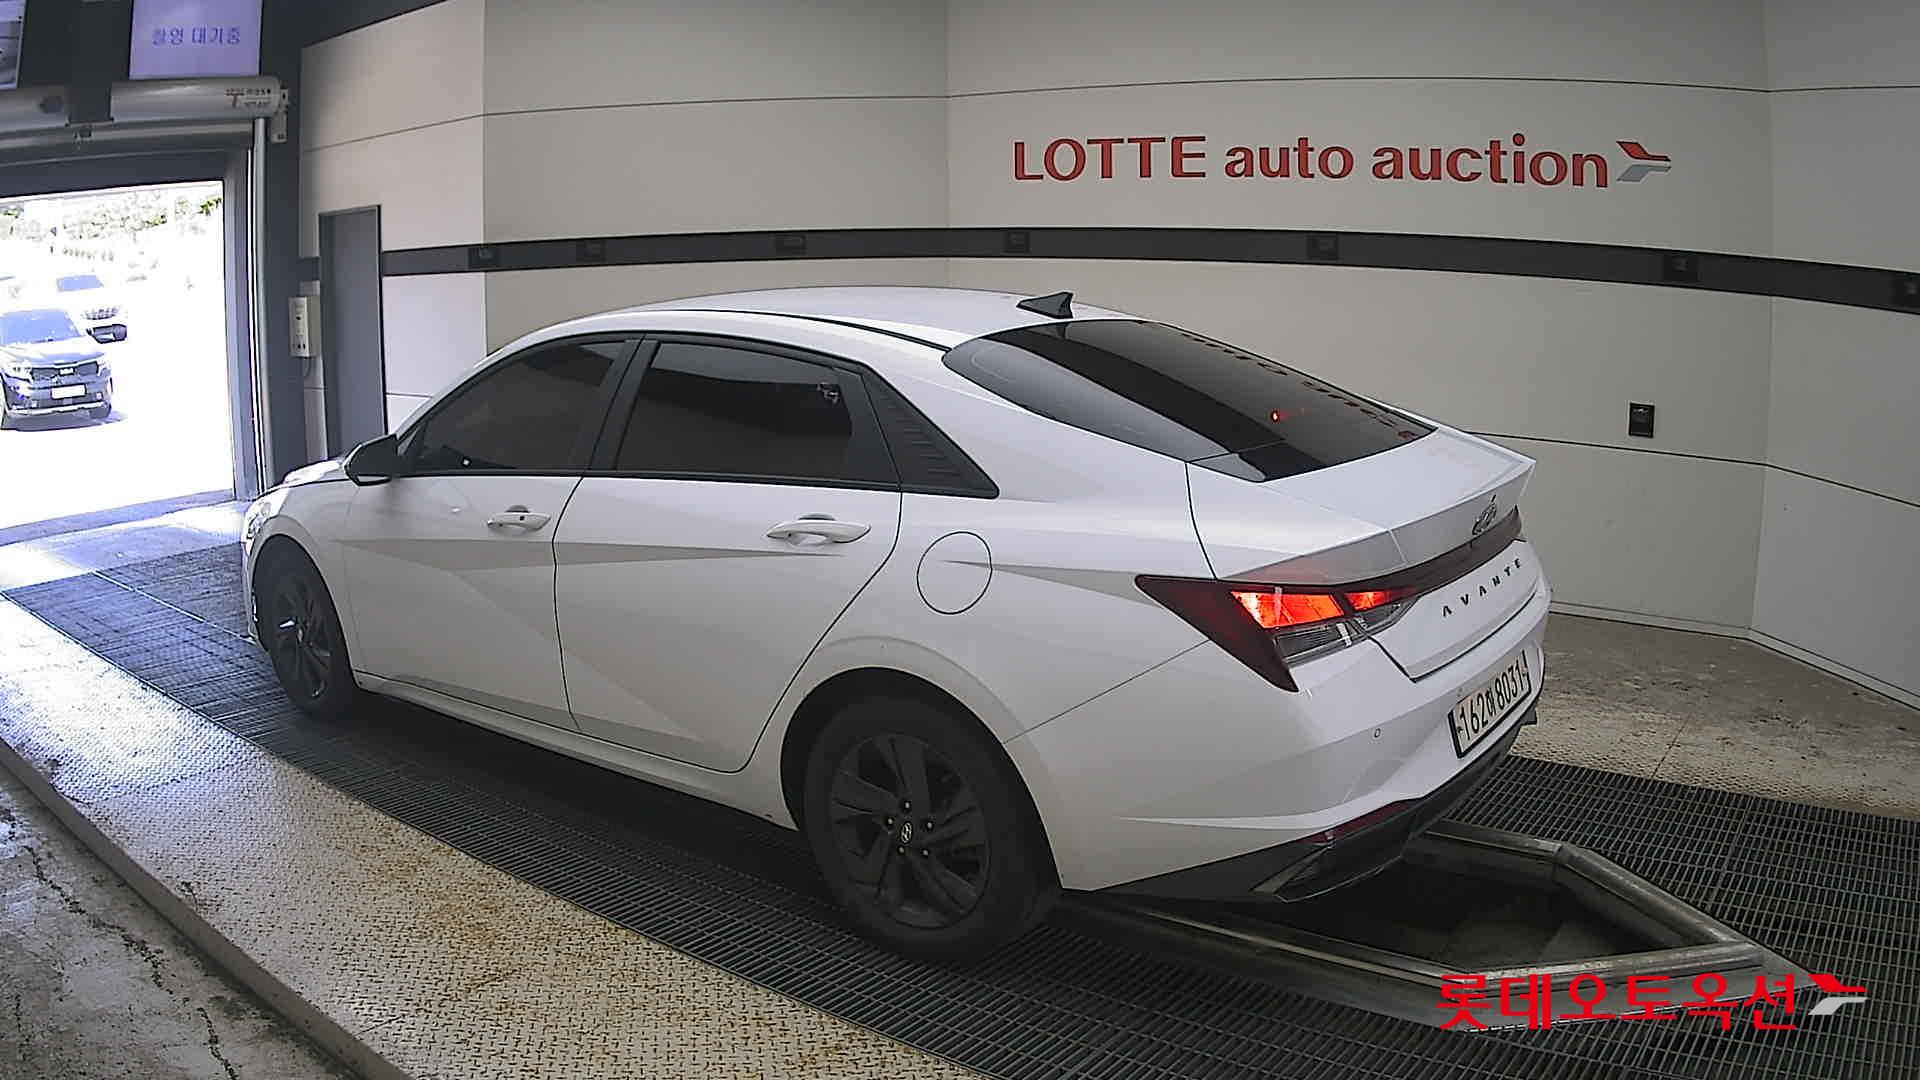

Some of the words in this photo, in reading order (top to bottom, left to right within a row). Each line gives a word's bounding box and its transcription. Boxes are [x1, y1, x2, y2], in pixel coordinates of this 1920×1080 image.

[191, 27, 240, 46] 대기중
[1014, 136, 1206, 181] LOTTE
[1224, 137, 1354, 179] auto
[1372, 133, 1608, 188] auction
[1442, 557, 1521, 617] AVANTE
